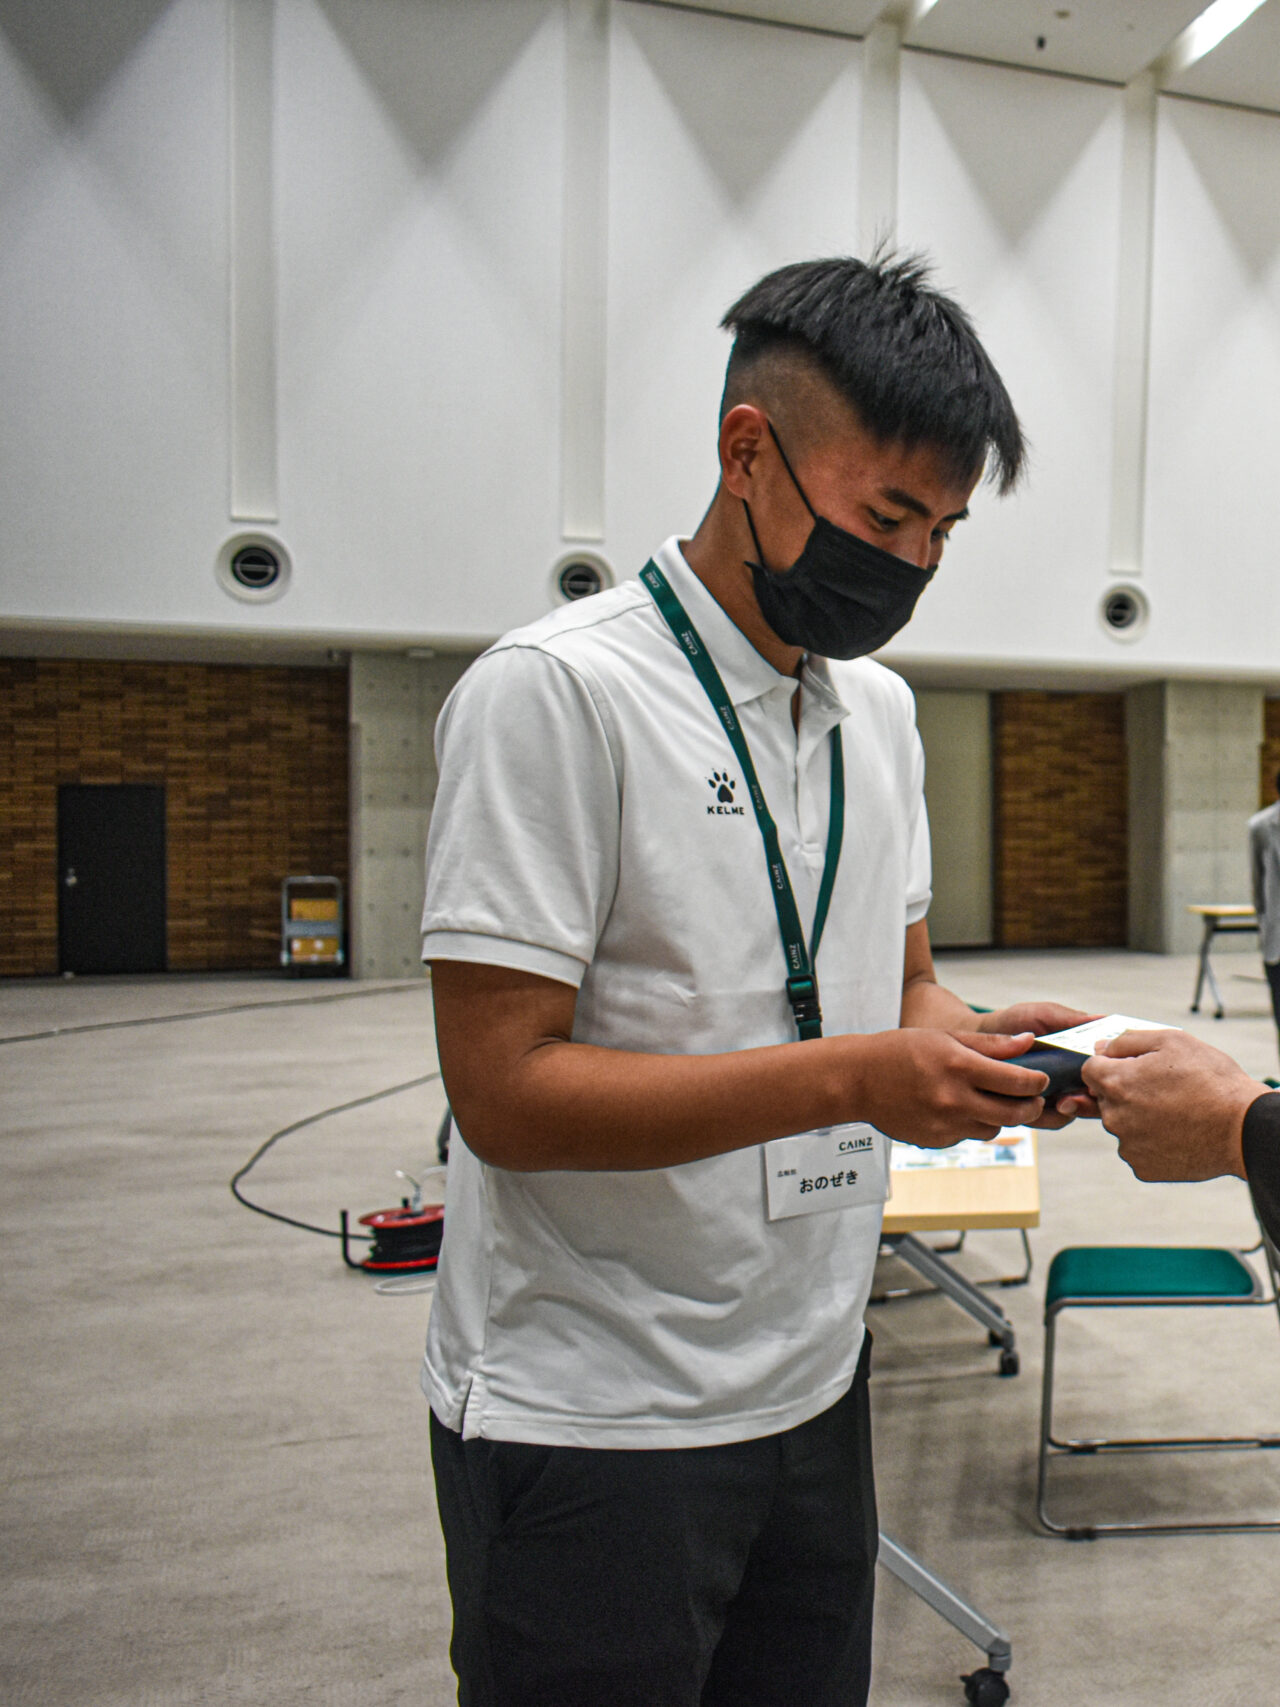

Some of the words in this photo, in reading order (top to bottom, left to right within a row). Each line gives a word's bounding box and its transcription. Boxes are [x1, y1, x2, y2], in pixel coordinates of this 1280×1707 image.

[681, 632, 698, 655] CAINZ
[707, 806, 745, 815] KELME
[772, 865, 783, 890] CAINZ
[790, 944, 800, 970] CAINZ
[839, 1137, 873, 1150] CAINZ
[799, 1170, 858, 1194] おのぜき
